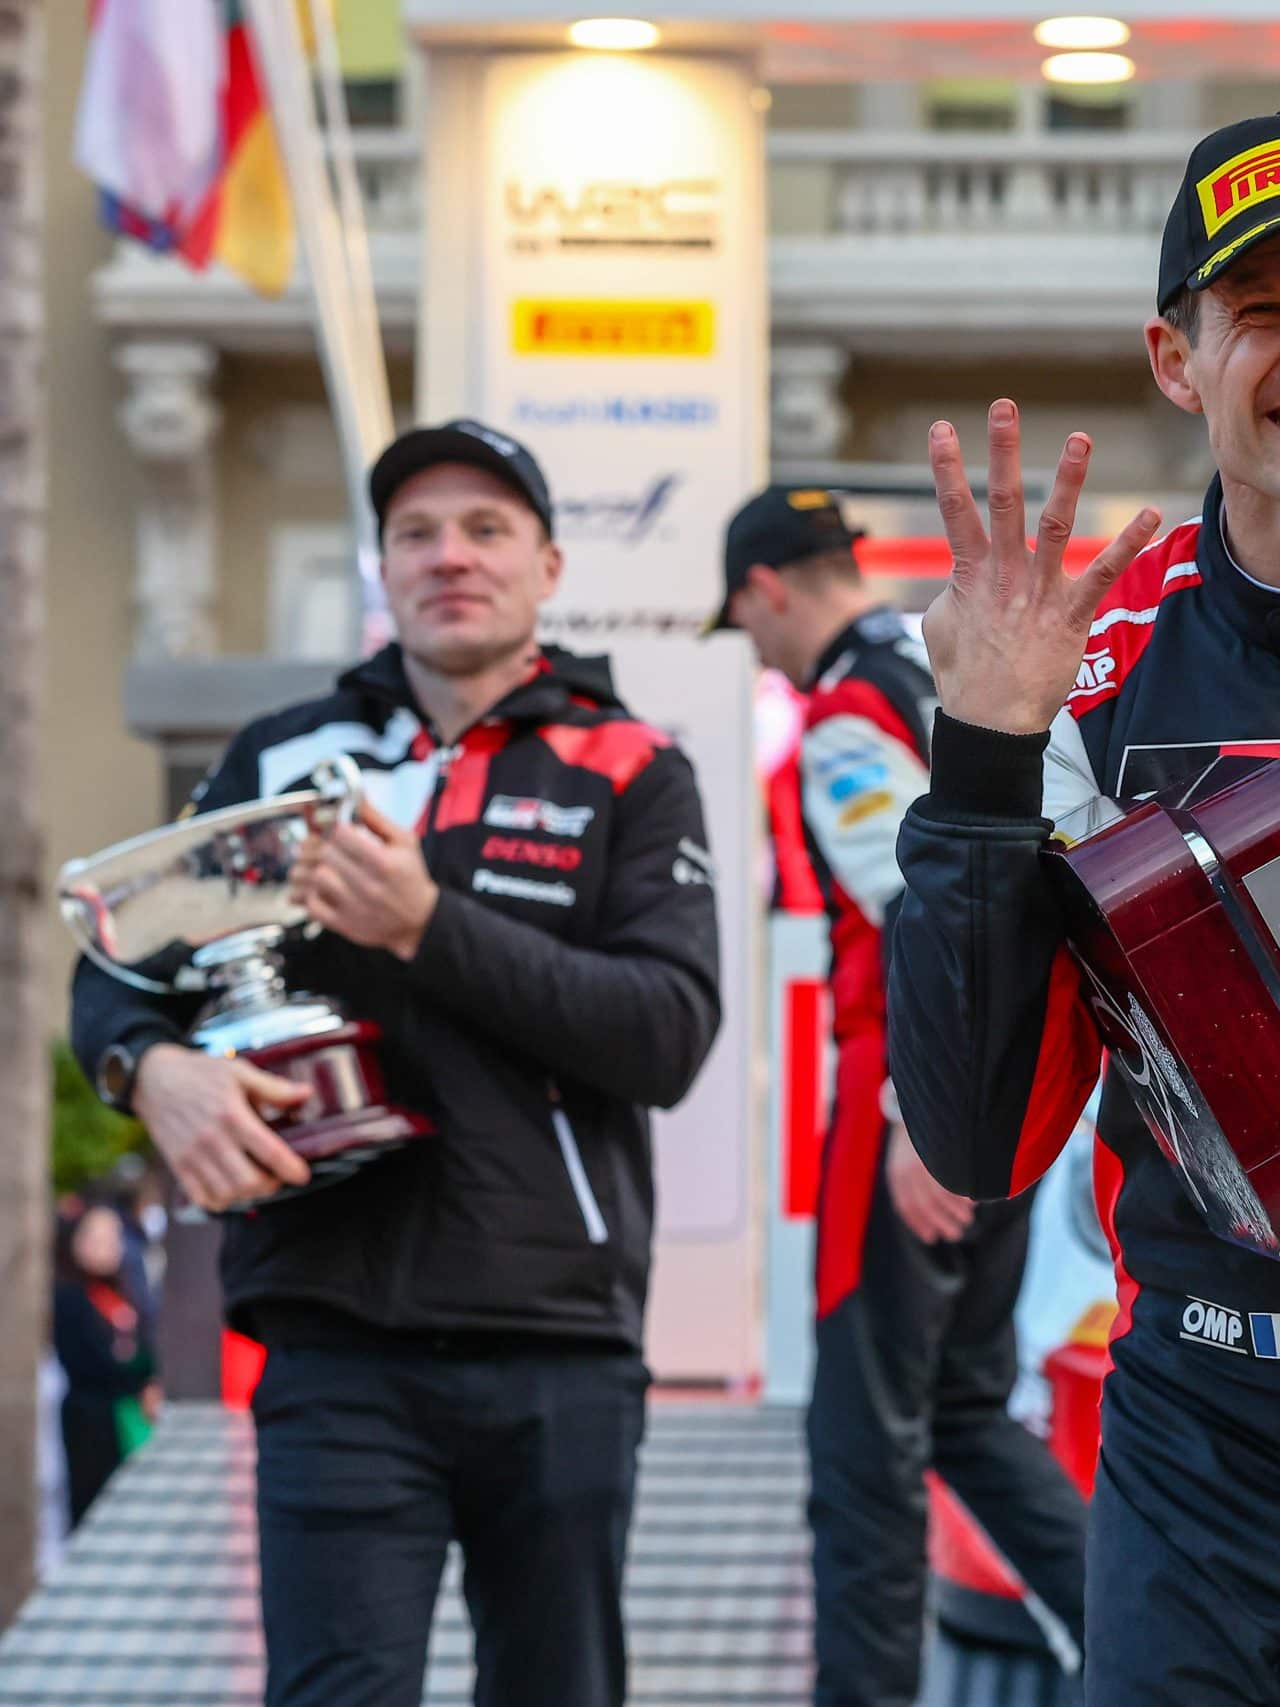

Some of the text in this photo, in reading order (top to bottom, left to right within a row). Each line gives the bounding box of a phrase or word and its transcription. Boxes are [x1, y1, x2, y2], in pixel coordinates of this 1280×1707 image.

[1072, 656, 1116, 690] MP
[482, 836, 583, 871] DENSO
[1182, 1301, 1243, 1346] OMP
